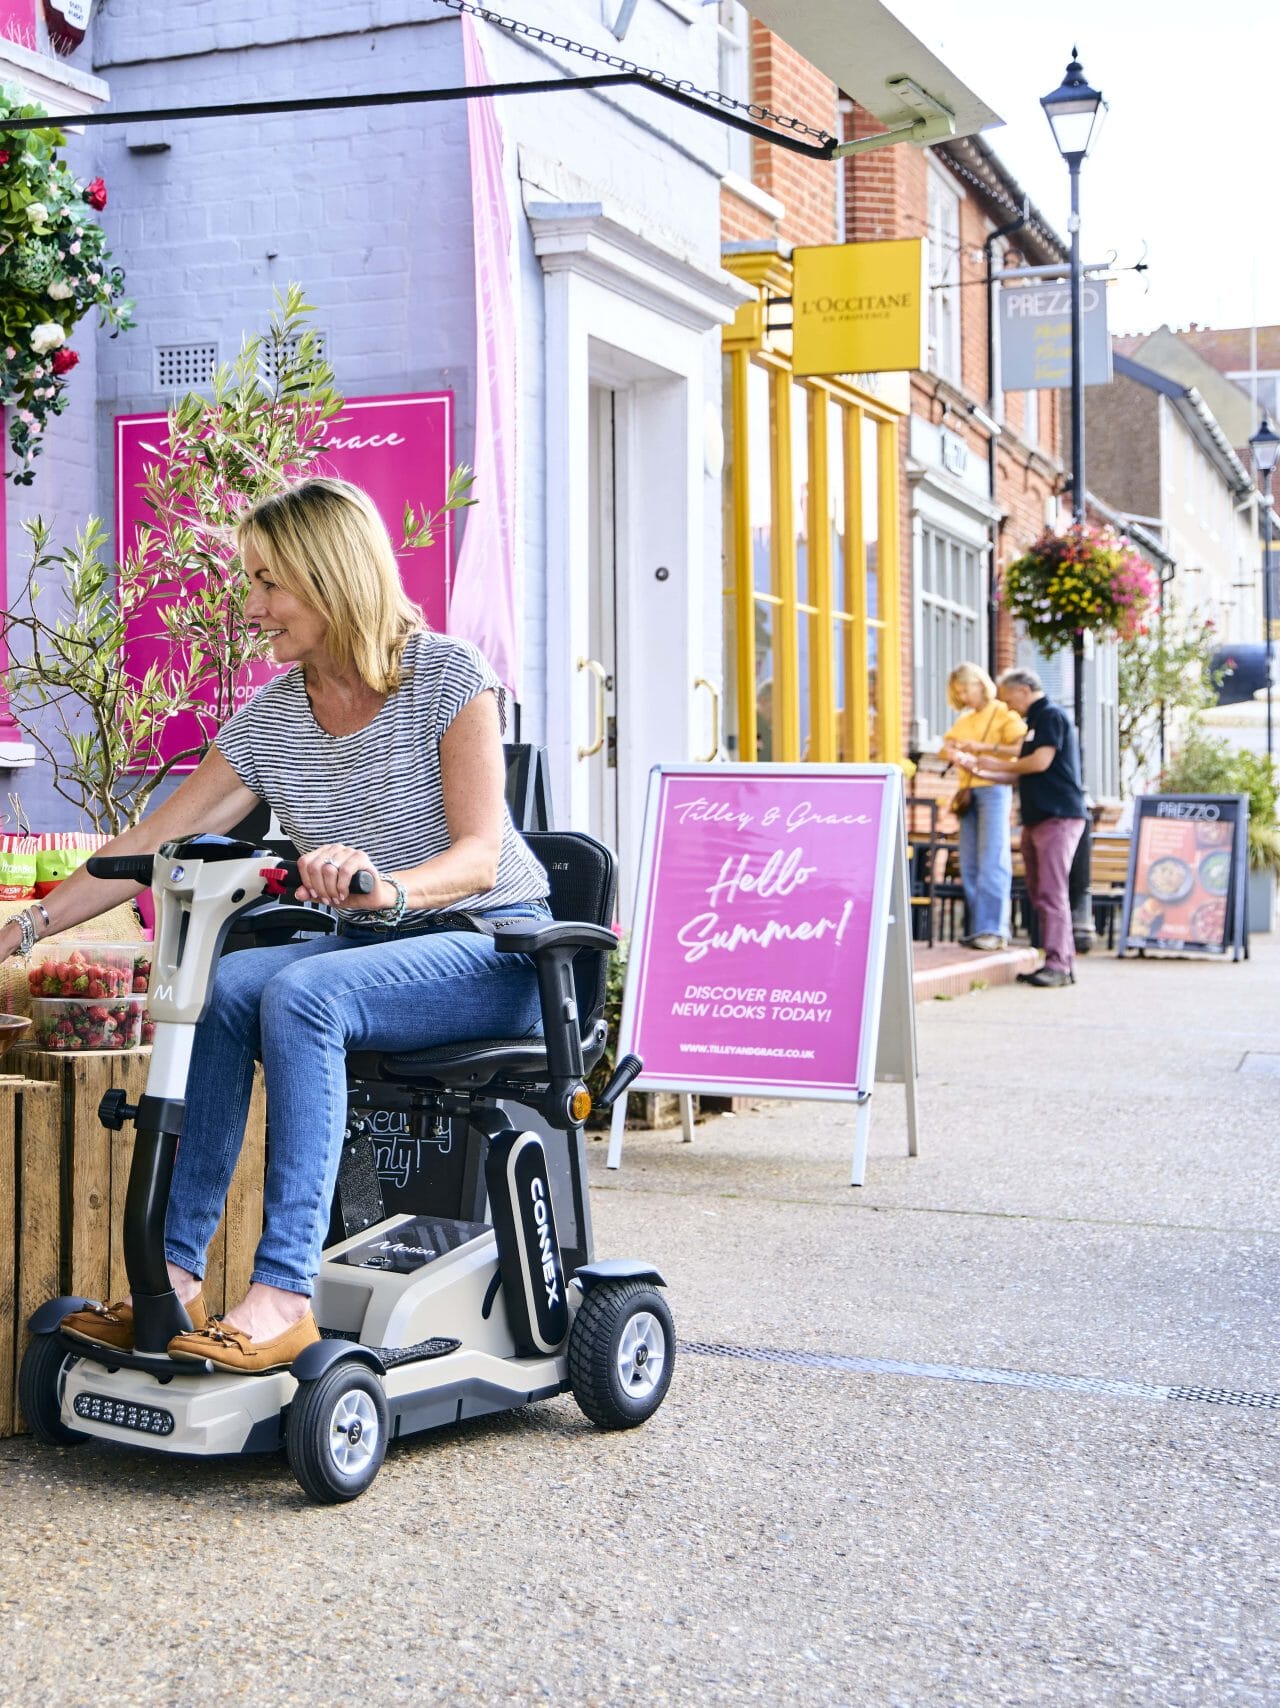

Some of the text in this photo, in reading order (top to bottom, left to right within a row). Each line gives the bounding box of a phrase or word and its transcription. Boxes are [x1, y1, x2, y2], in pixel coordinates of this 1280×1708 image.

[673, 797, 872, 833] Tilley & Grace
[1156, 801, 1221, 822] PREZZO
[705, 847, 818, 908] Hello
[677, 899, 854, 963] Summer!
[684, 985, 828, 1005] DISCOVER BRAND
[671, 1002, 832, 1022] NEW LOOKS TODAY!
[679, 1043, 816, 1060] WWW.TILLEYANDGRACE.CO.UK
[372, 1136, 421, 1189] nly!
[367, 1240, 437, 1256] Motion
[530, 1176, 560, 1310] CONNEX
